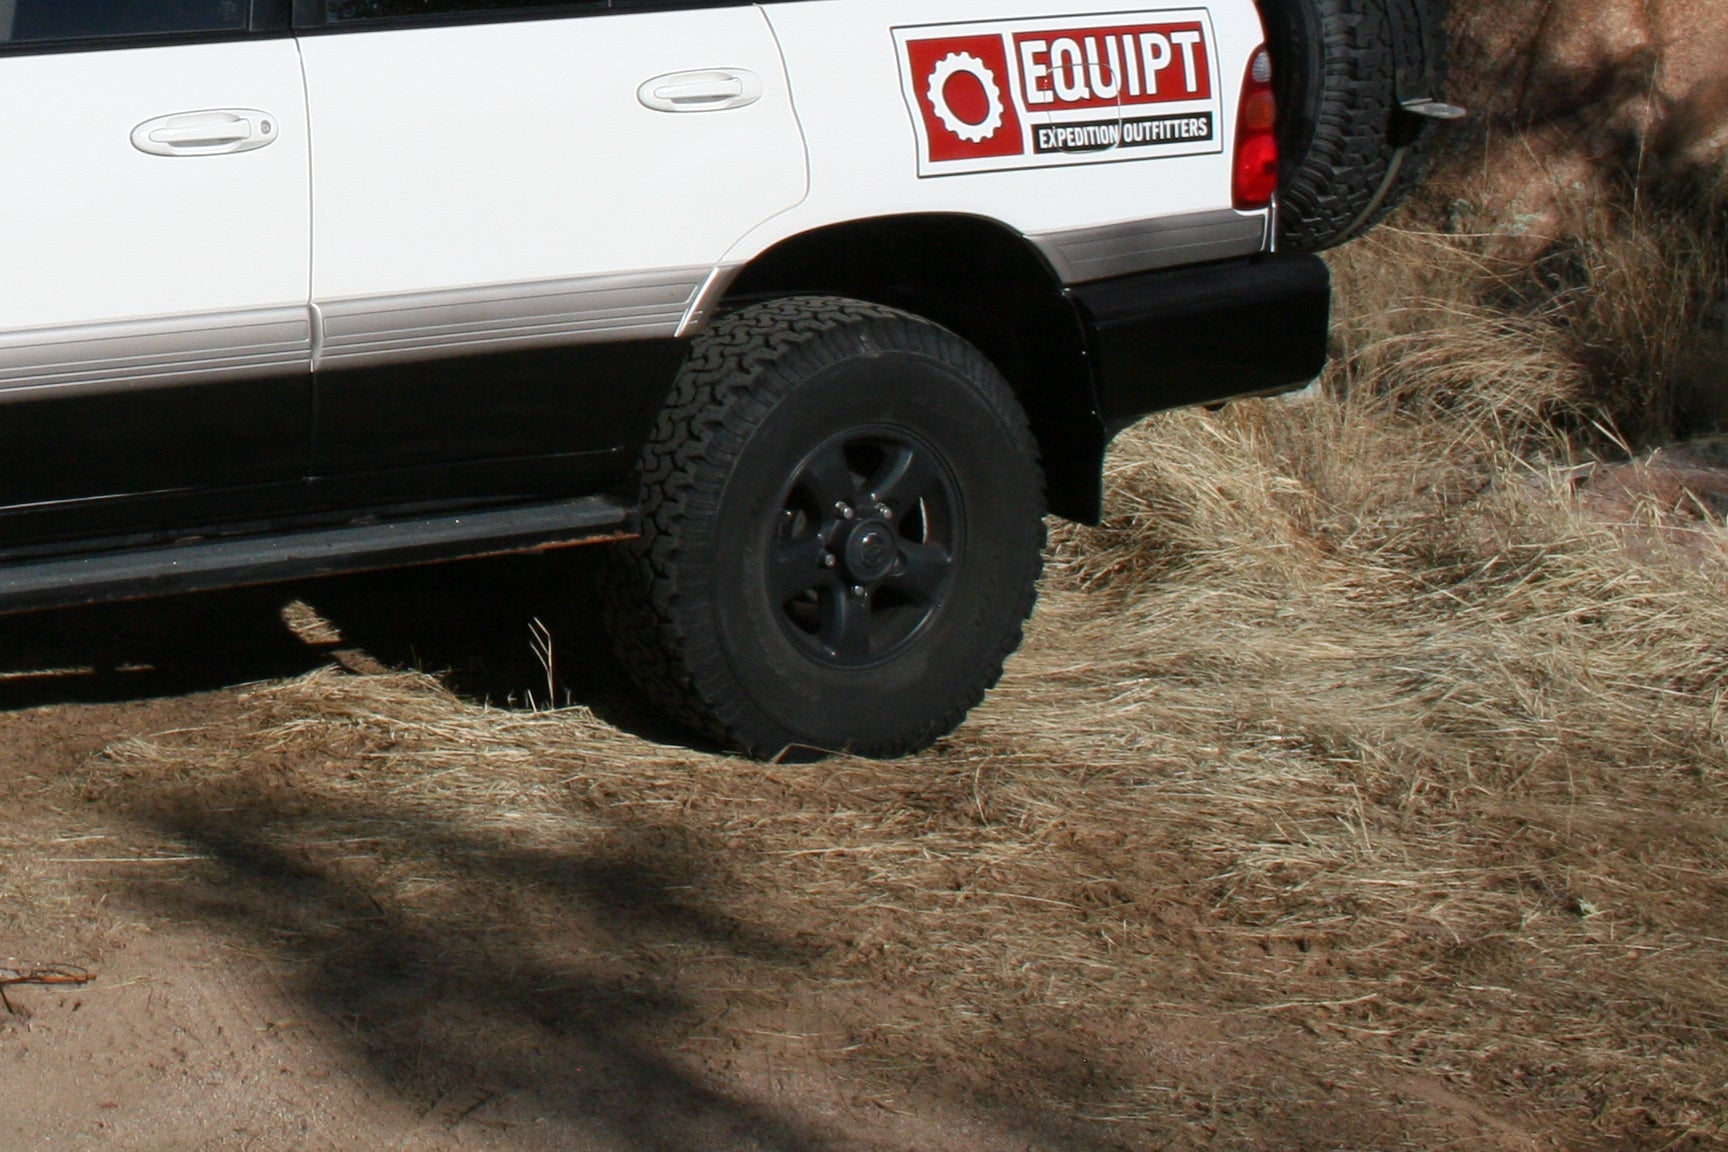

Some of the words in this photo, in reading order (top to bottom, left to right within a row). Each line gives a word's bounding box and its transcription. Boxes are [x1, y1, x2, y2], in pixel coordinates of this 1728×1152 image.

[1020, 31, 1201, 104] EQUIPT
[1038, 124, 1120, 149] EXPEDITION
[1124, 117, 1208, 143] OUTFITTERS
